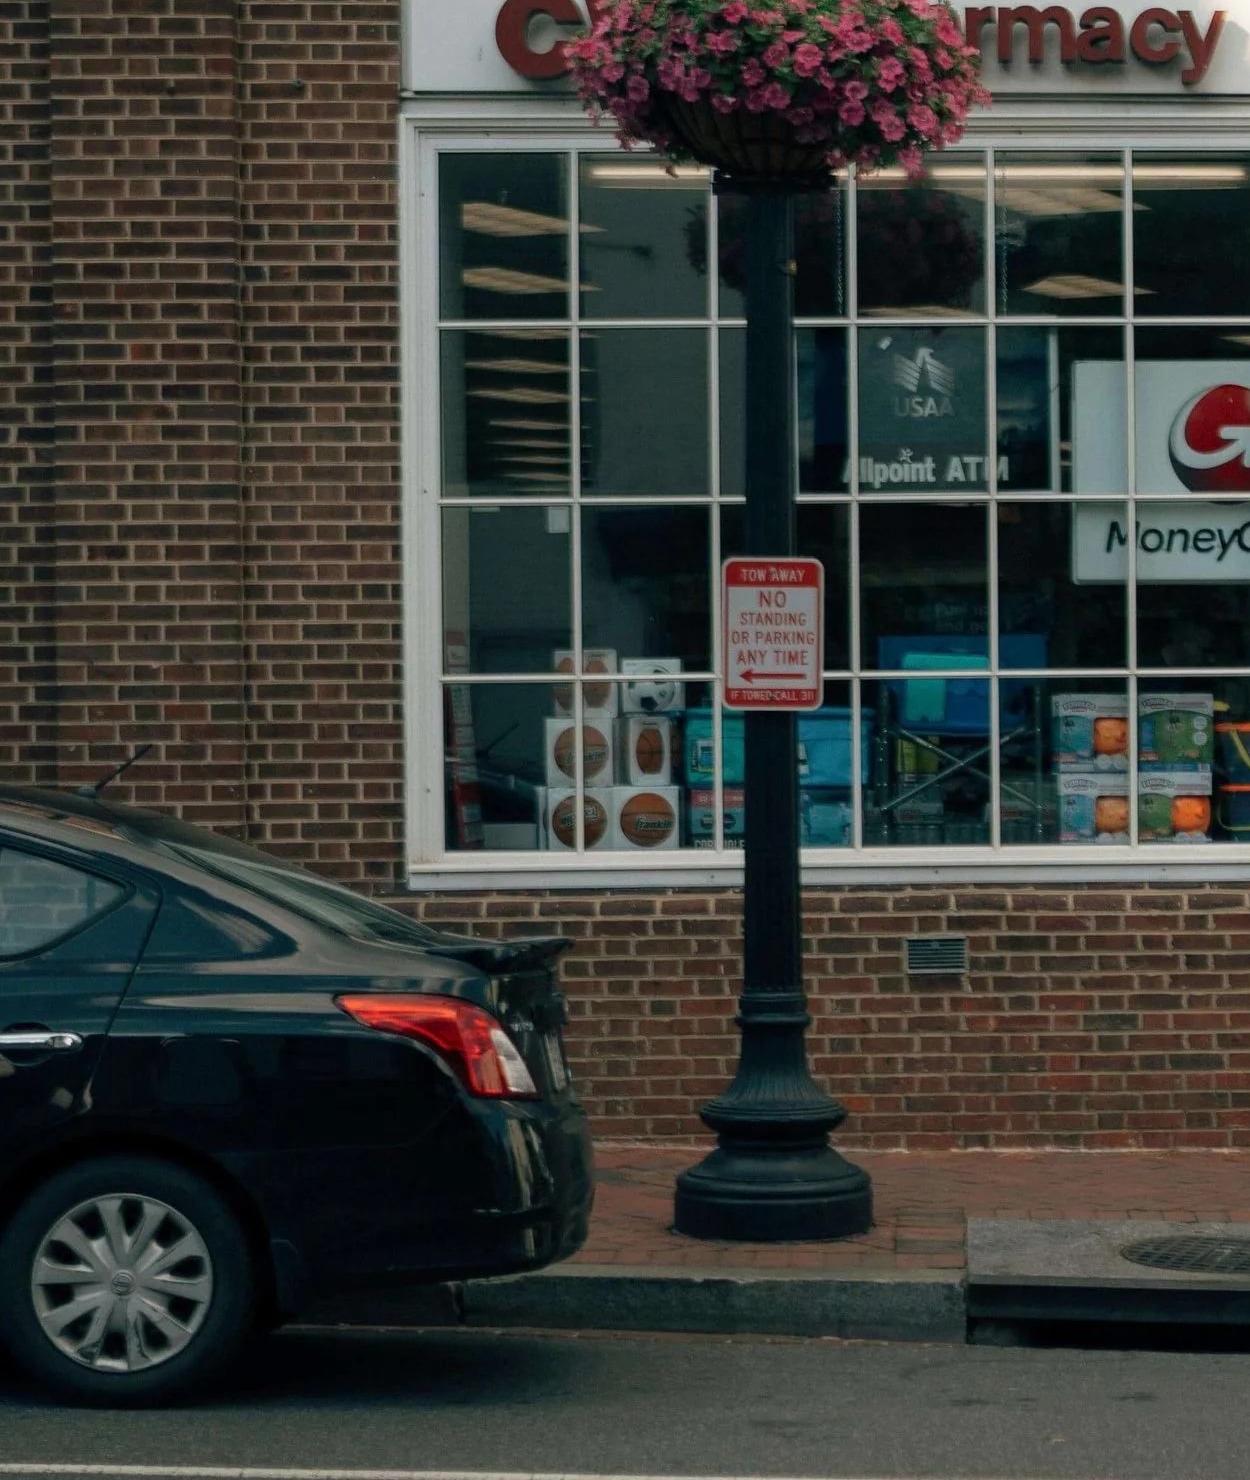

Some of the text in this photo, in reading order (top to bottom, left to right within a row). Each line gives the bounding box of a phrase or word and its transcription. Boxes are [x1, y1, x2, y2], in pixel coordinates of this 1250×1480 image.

[896, 397, 955, 417] USAA
[945, 455, 1010, 482] ATM
[741, 569, 806, 583] TOW AWAY
[758, 590, 787, 608] NO
[740, 612, 807, 626] STANDING
[731, 630, 815, 646] OR PARKING
[736, 650, 810, 666] ANY TIME
[731, 690, 740, 701] IF
[775, 690, 799, 701] CALL
[801, 690, 815, 701] 311
